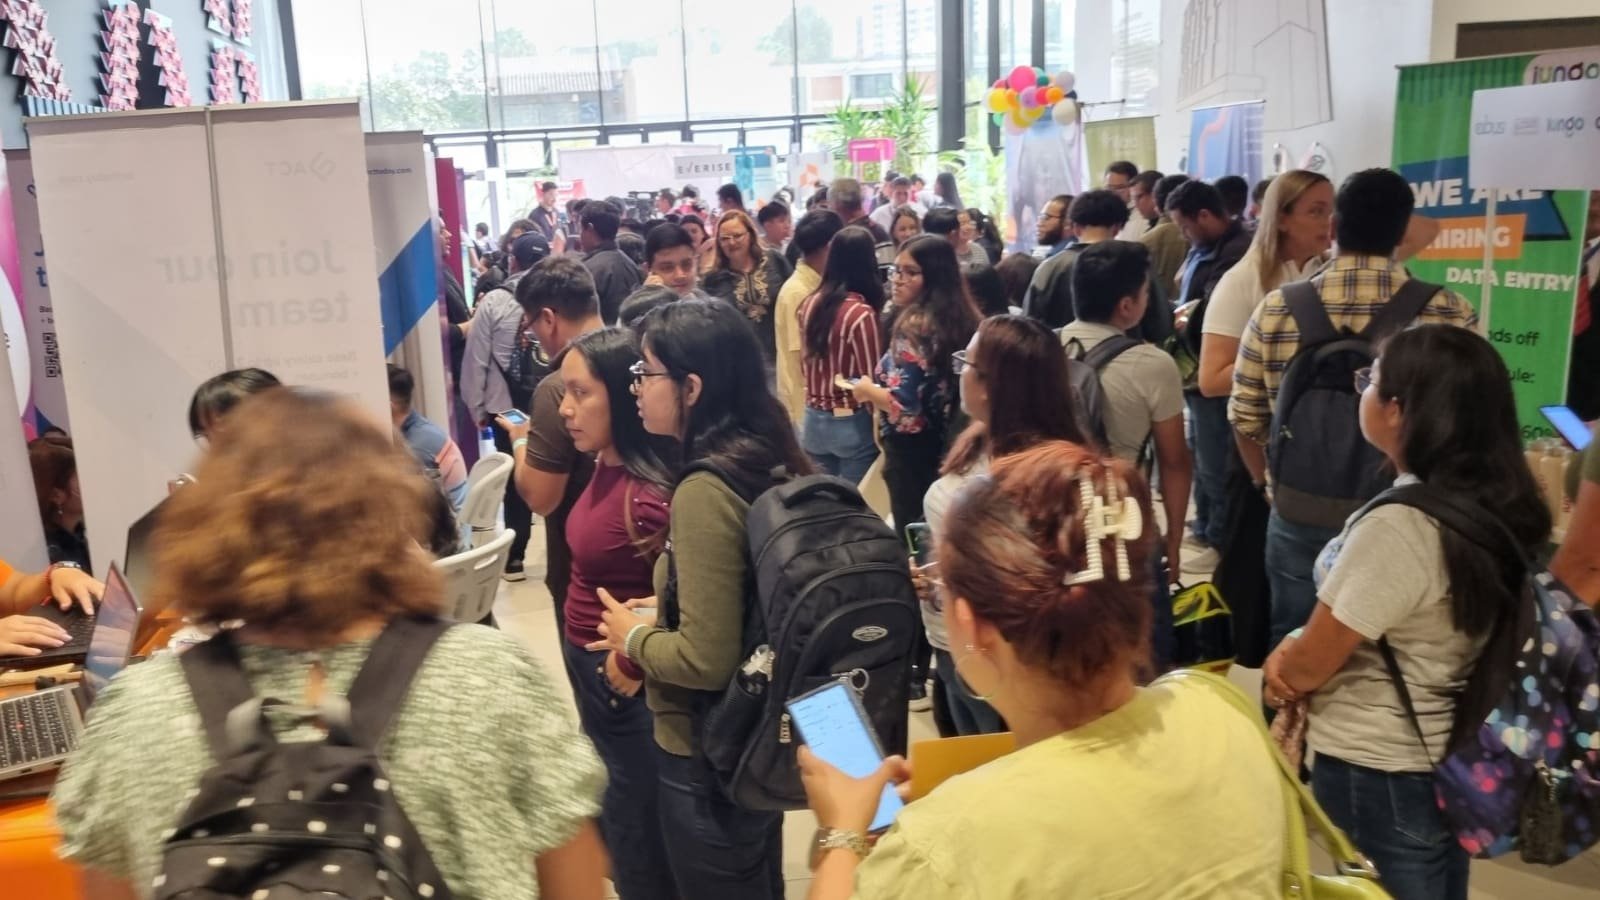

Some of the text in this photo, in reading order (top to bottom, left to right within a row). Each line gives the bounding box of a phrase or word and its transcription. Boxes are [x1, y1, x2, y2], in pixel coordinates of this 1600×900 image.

[1409, 178, 1463, 208] WE
[1446, 267, 1575, 292] DATA ENTRY
[1515, 331, 1541, 347] off
